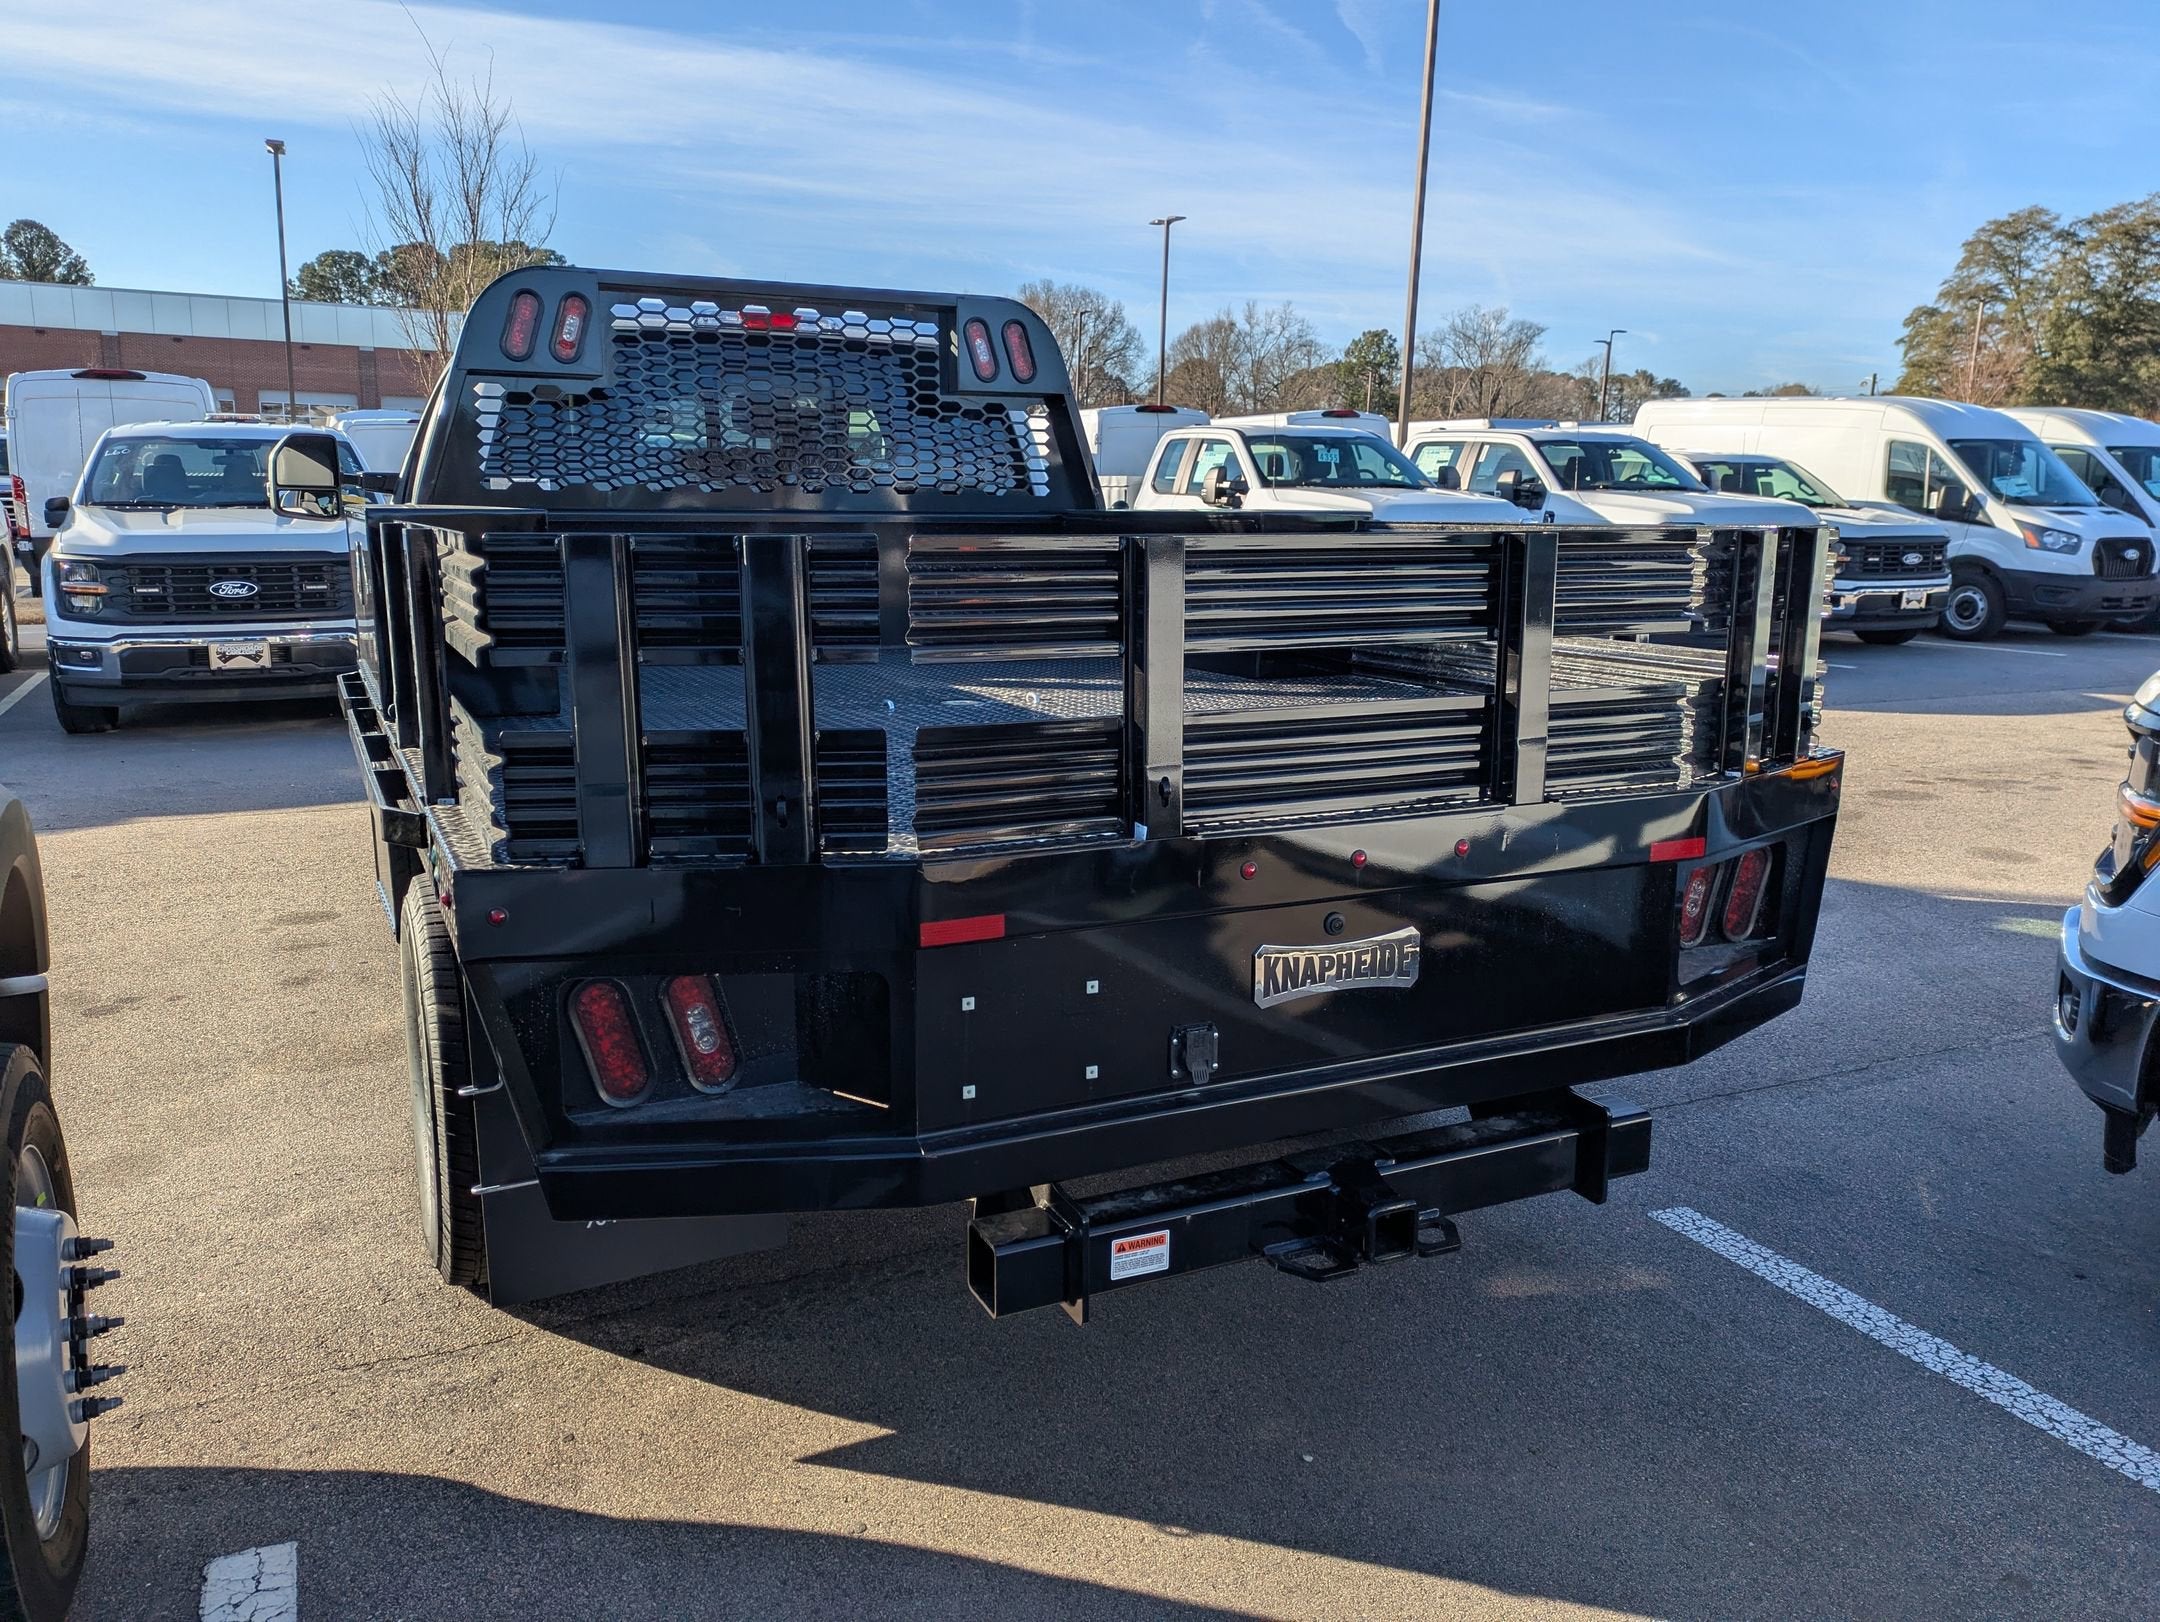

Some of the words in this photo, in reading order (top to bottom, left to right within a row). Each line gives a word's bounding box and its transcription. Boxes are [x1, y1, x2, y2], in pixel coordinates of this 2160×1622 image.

[218, 583, 249, 595] Ford
[1263, 943, 1413, 999] KNAPHEIDE
[1128, 1235, 1165, 1250] WARNING
